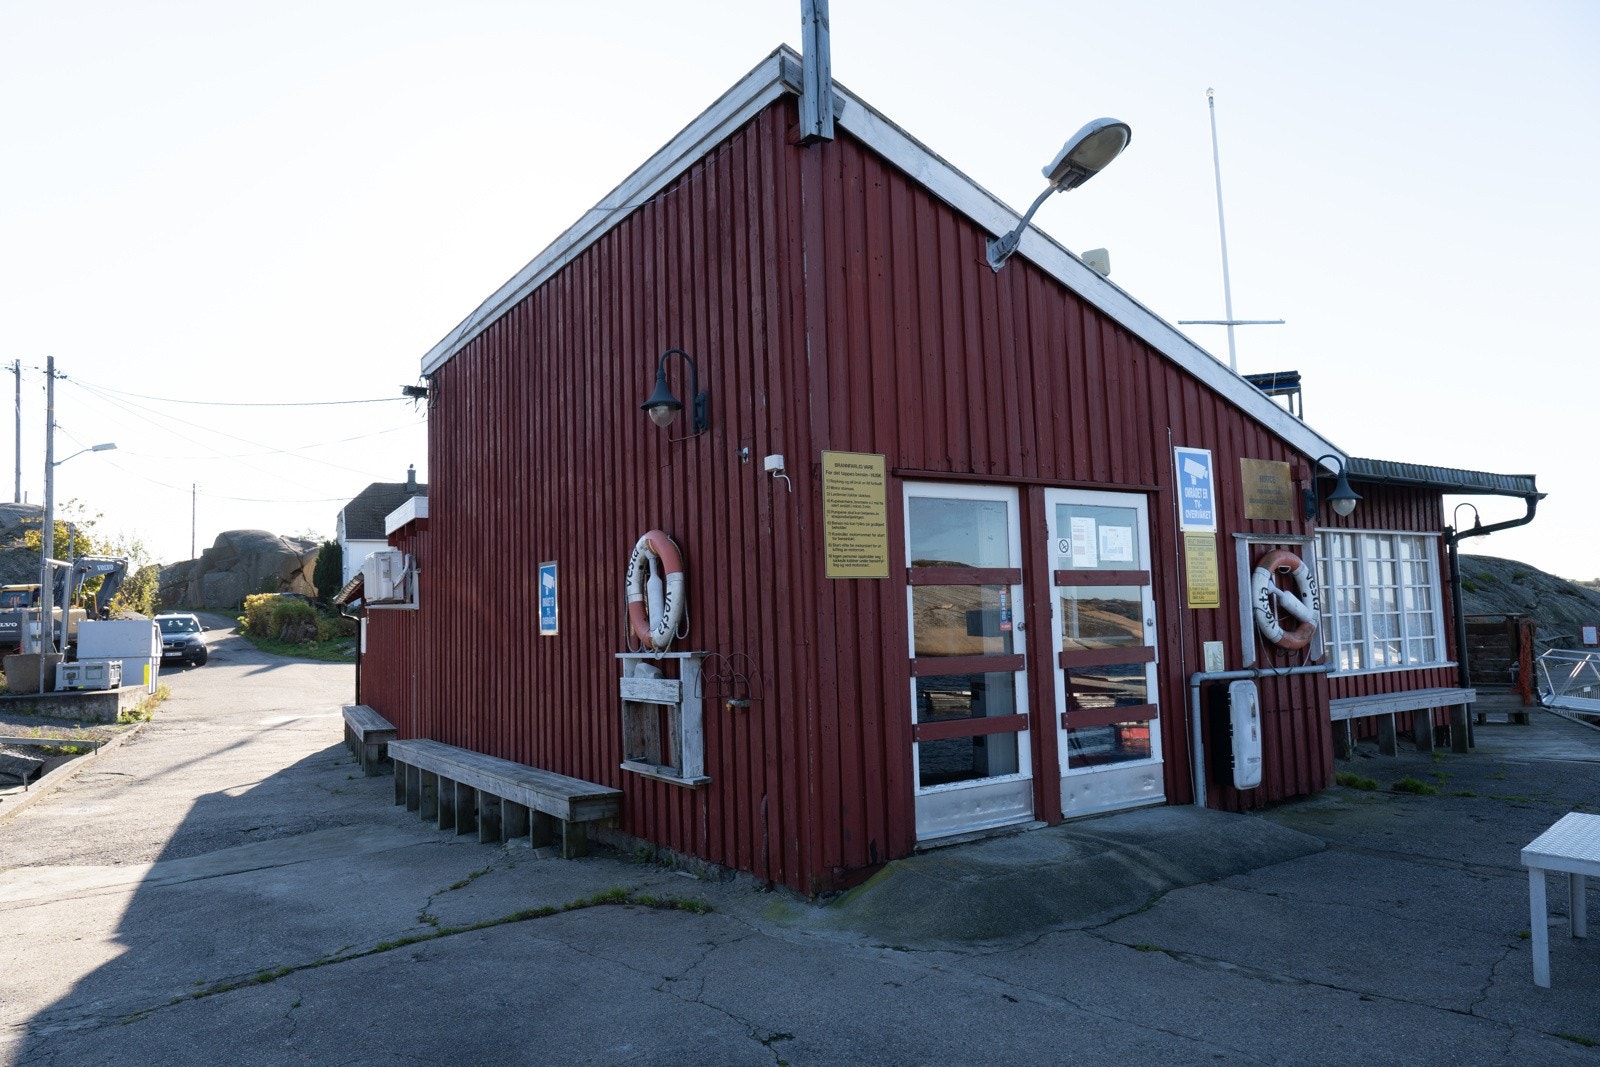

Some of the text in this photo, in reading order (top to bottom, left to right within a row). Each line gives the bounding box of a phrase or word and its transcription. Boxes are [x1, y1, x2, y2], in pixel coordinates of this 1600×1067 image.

[1184, 486, 1208, 499] OMRÅDET ER
[1194, 500, 1202, 508] TV-
[1185, 509, 1211, 519] OVERVÅKET
